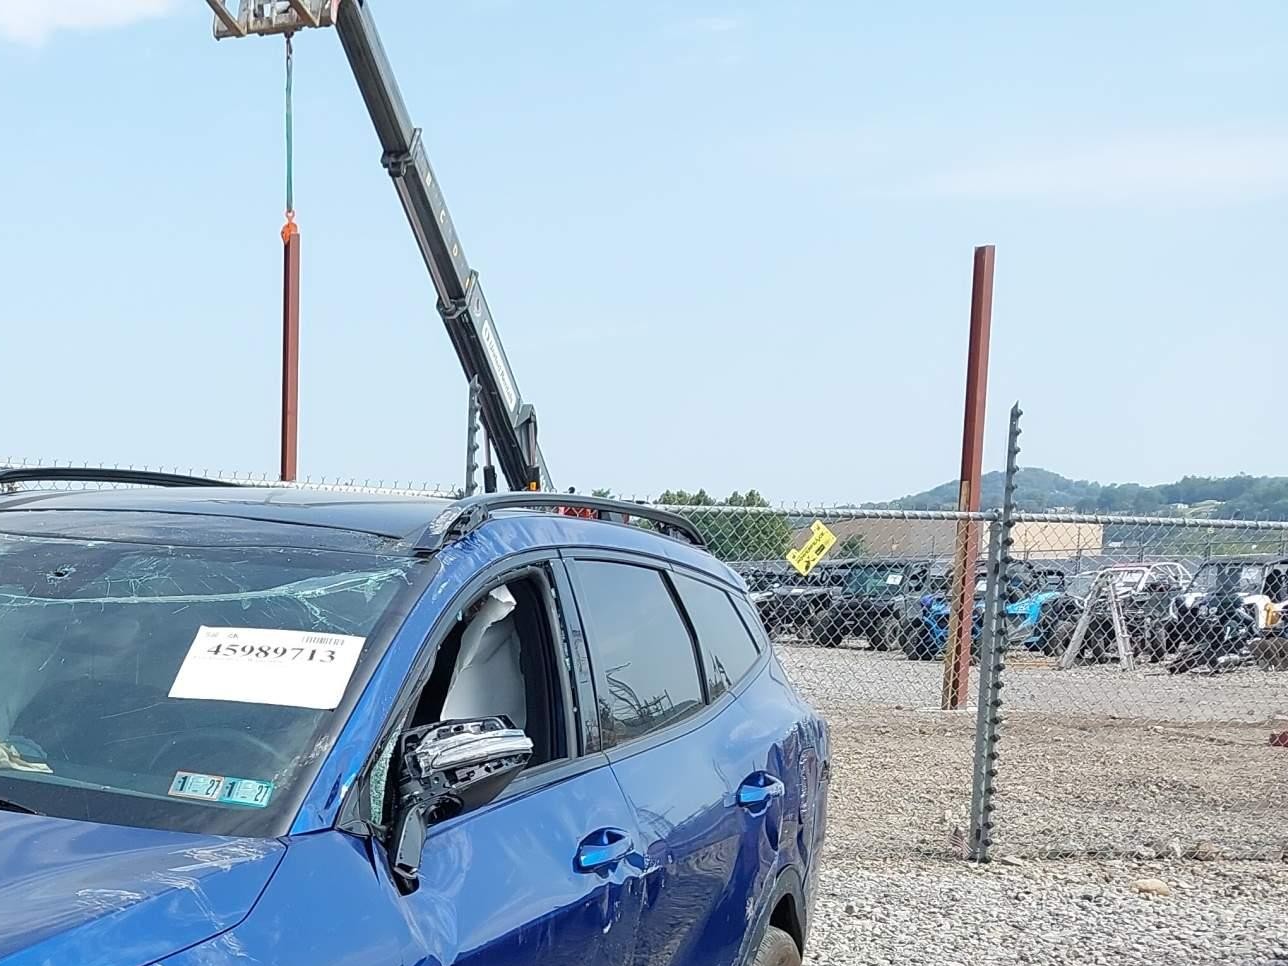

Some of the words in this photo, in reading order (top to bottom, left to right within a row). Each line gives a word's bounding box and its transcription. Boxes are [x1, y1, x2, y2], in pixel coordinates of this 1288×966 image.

[207, 643, 336, 663] 45989713
[205, 779, 221, 798] 27
[254, 785, 270, 803] 27
